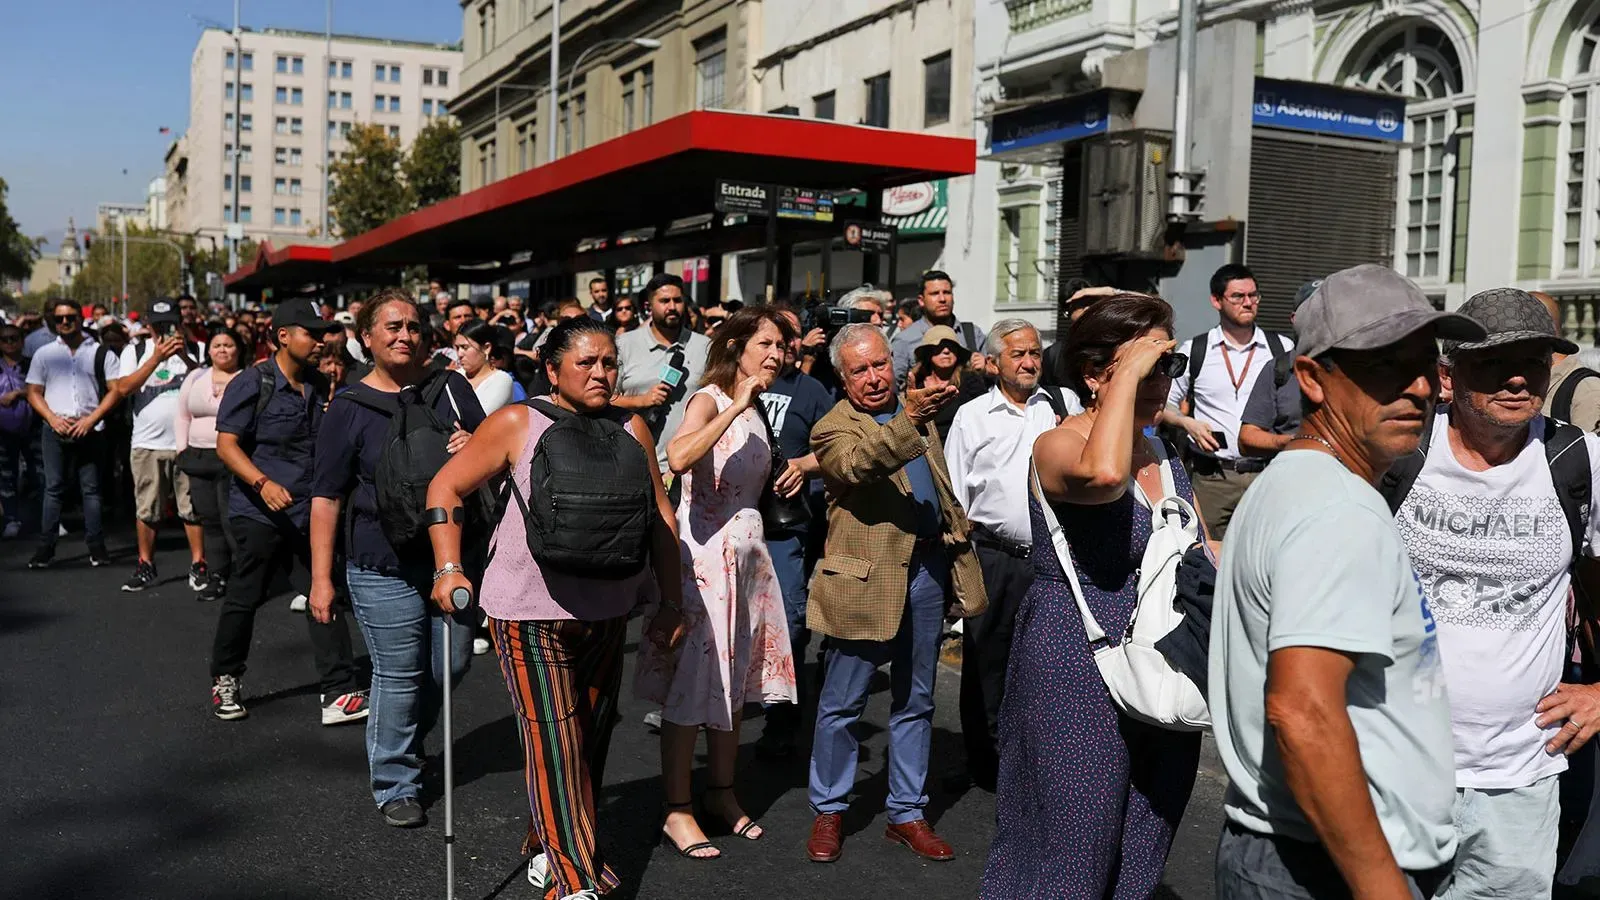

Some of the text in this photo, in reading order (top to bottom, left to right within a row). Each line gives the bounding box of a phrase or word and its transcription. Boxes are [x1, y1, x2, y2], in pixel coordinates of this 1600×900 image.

[1277, 98, 1344, 122] Ascensor
[721, 183, 766, 199] Entrada
[1413, 504, 1546, 538] MICHAEL
